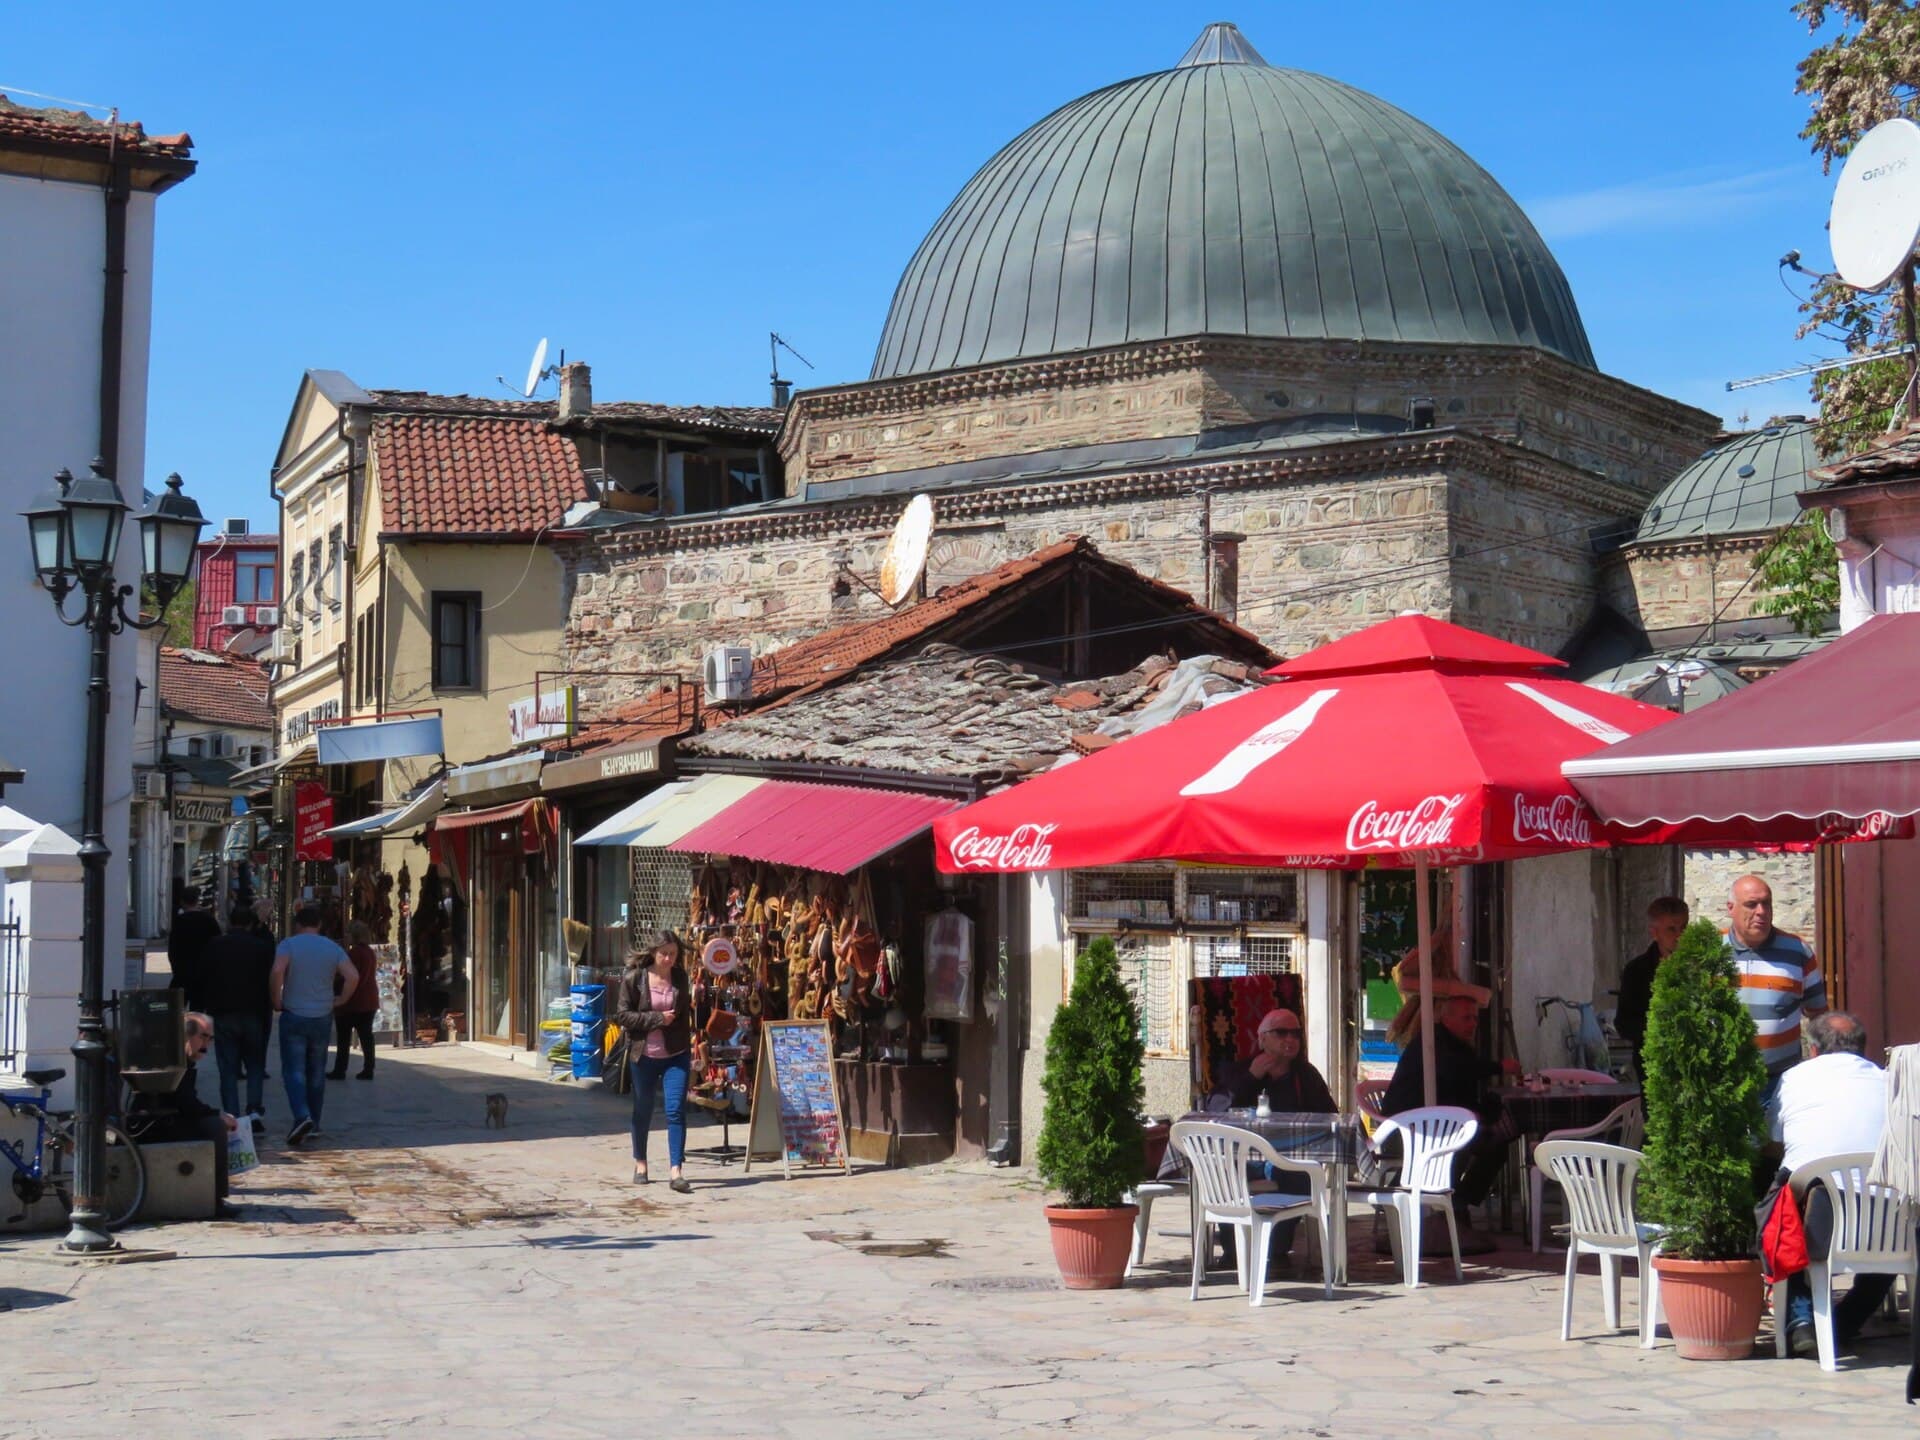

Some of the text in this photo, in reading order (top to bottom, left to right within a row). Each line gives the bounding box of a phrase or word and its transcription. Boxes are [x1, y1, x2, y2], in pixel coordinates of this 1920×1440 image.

[1862, 157, 1908, 181] ONYX
[298, 797, 334, 815] WELCOME
[310, 812, 321, 822] TO
[1345, 793, 1467, 851] Coca-Cola
[1513, 792, 1592, 843] Coca-Cola
[949, 823, 1060, 868] Coca-Cola
